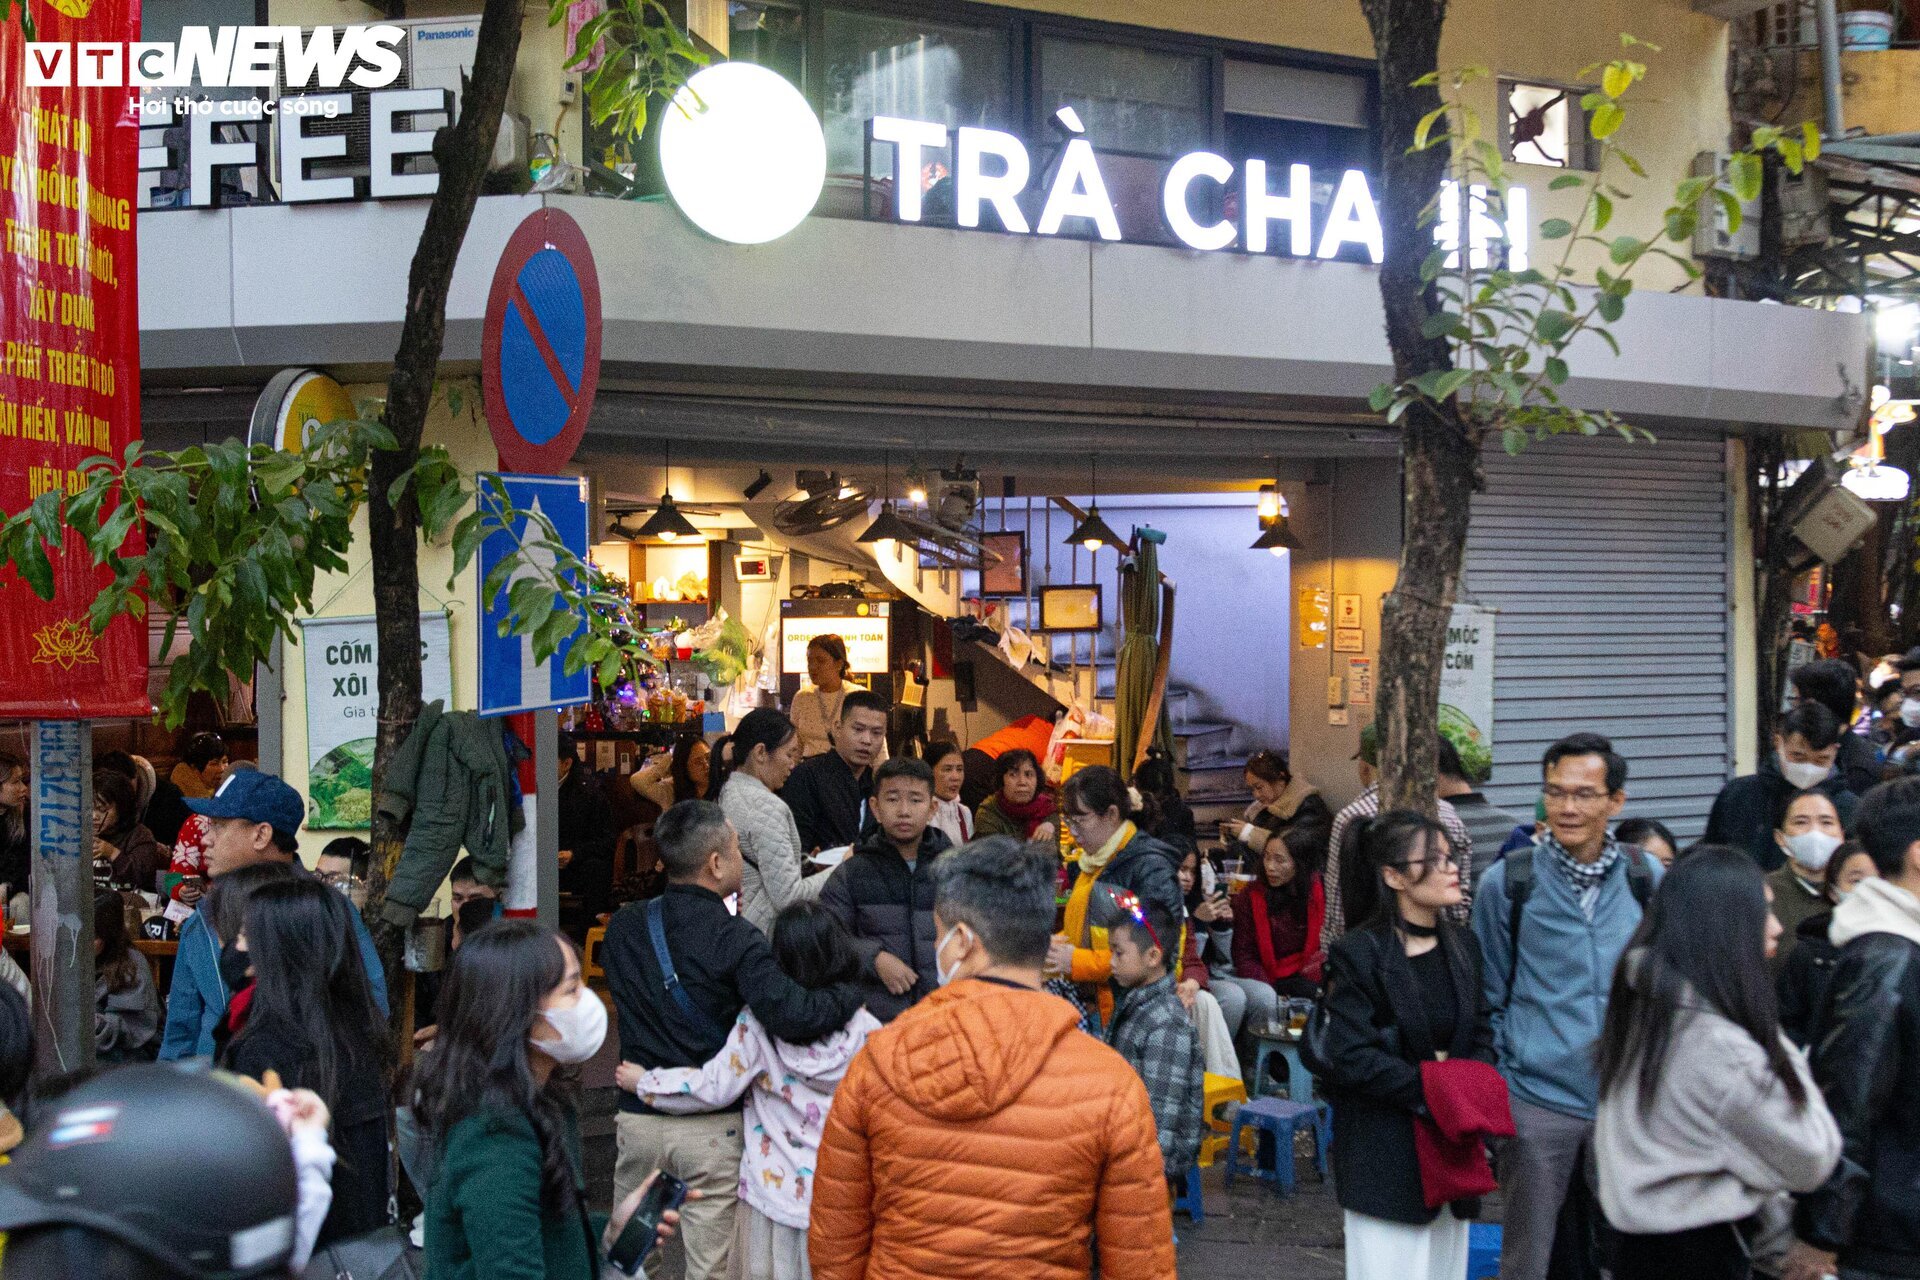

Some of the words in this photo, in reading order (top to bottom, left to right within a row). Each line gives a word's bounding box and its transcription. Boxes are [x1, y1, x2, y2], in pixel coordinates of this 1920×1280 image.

[418, 28, 475, 40] Panasonic
[872, 106, 1122, 241] TRÀ
[1163, 152, 1528, 273] CHAH
[29, 281, 57, 324] XÂY
[6, 338, 41, 381] PHÁT
[47, 339, 89, 389] TRIỂN
[22, 396, 60, 447] HIẾN,
[64, 404, 91, 447] VĂN
[325, 639, 372, 666] CỐM
[332, 673, 368, 697] XÔI
[343, 706, 366, 718] Gia
